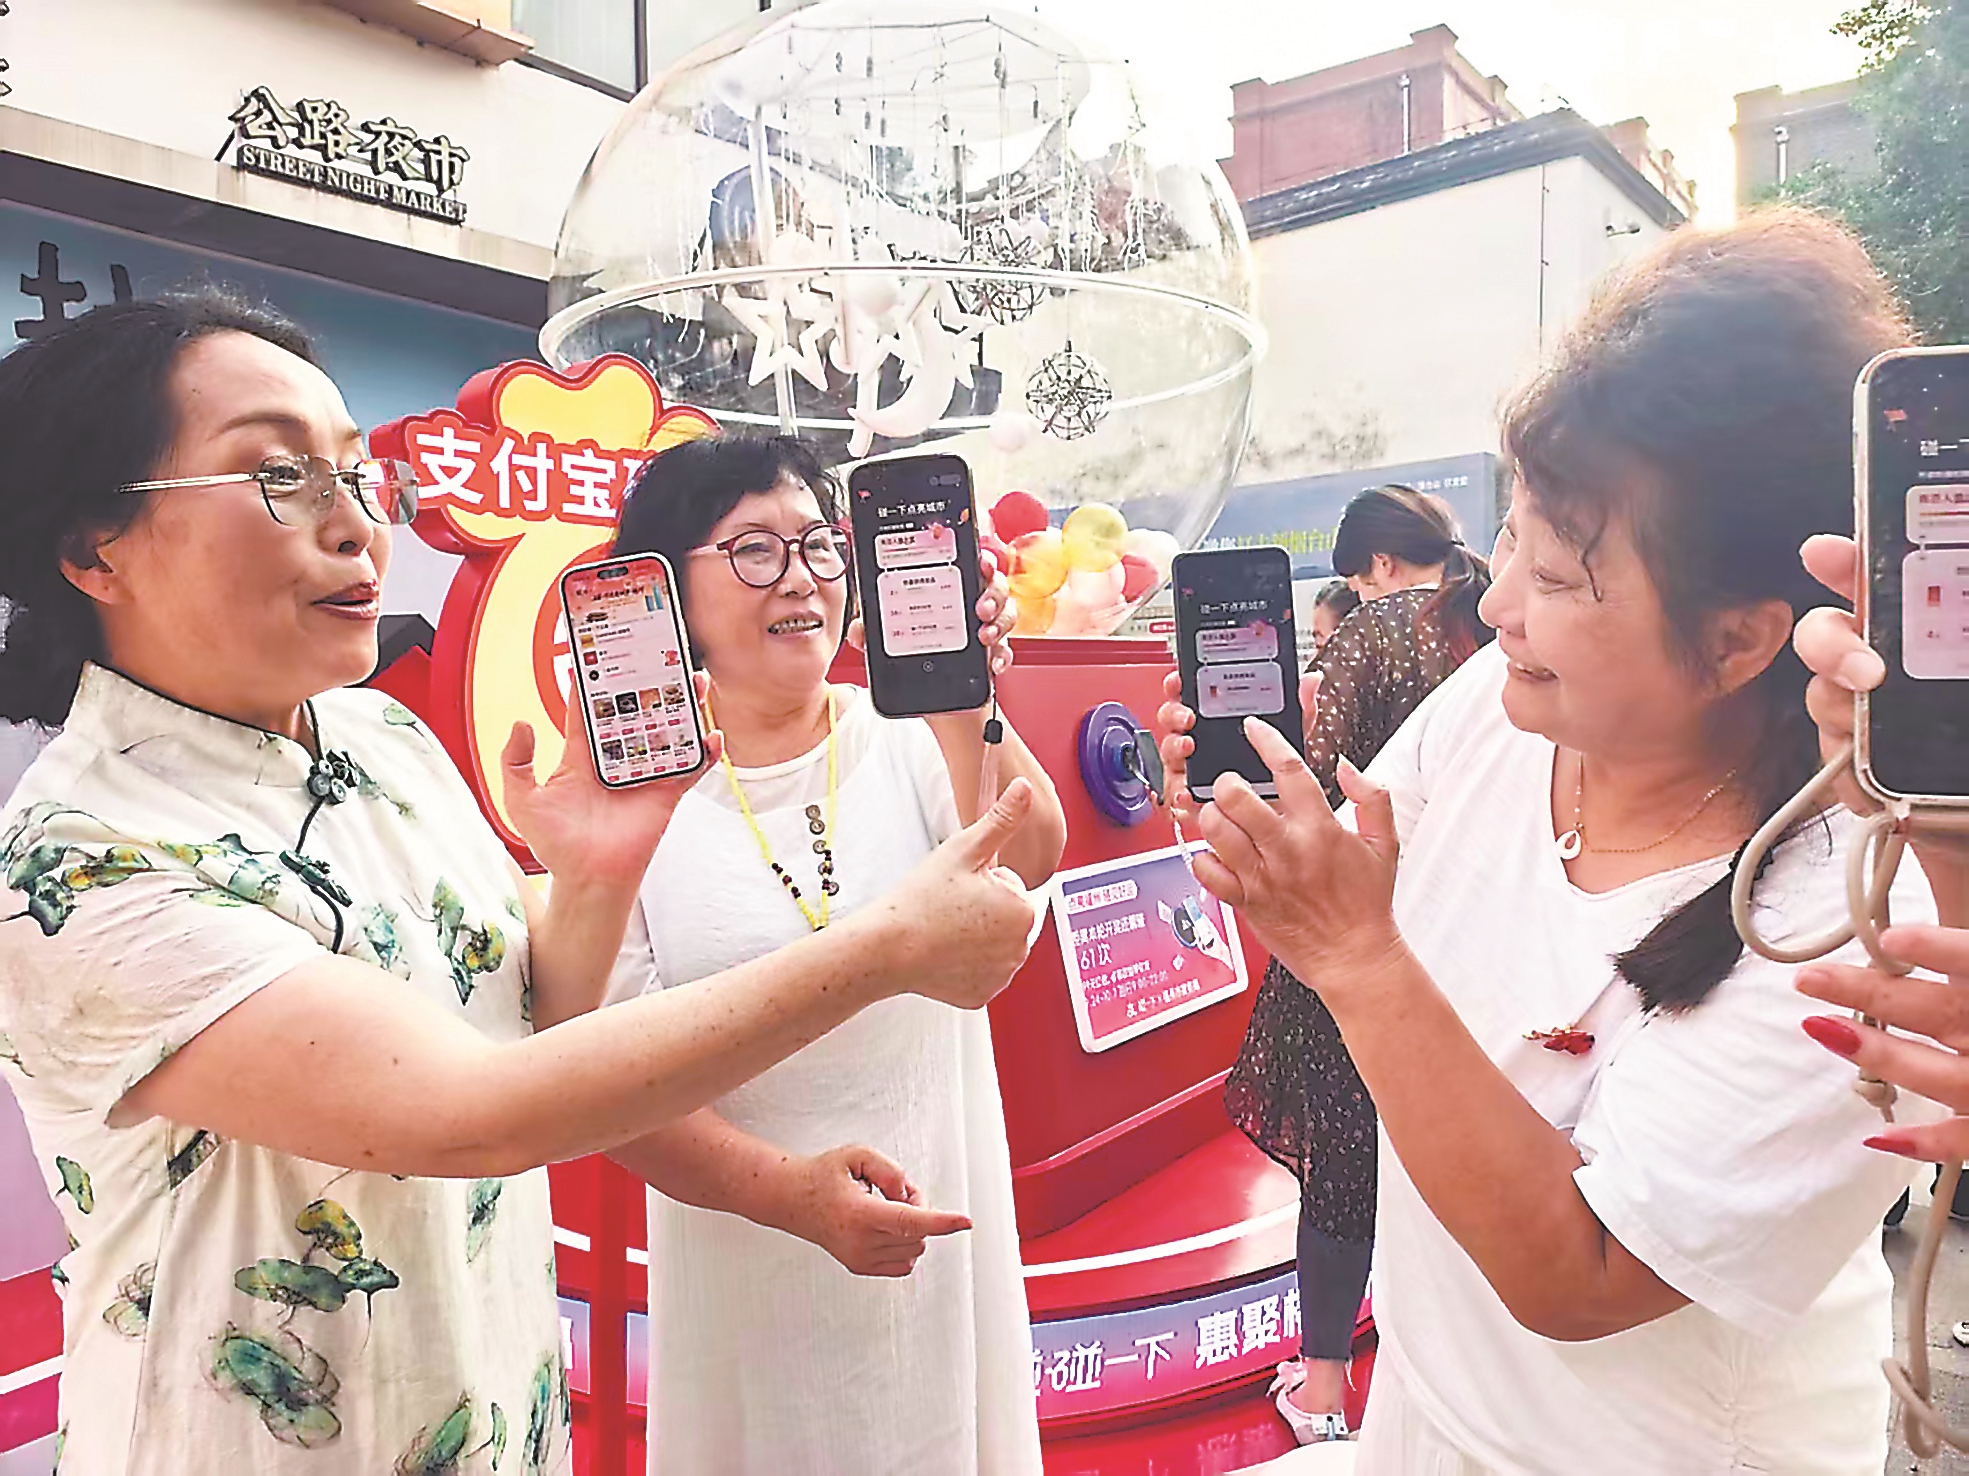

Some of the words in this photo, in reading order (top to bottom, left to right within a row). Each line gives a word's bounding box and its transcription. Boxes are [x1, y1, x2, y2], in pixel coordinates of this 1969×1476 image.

[228, 86, 470, 197] 公路夜市
[243, 145, 325, 184] STREET
[326, 166, 388, 200] NIGHT
[391, 186, 467, 223] MARKET
[416, 427, 652, 518] 支付宝
[1080, 943, 1112, 971] 61次
